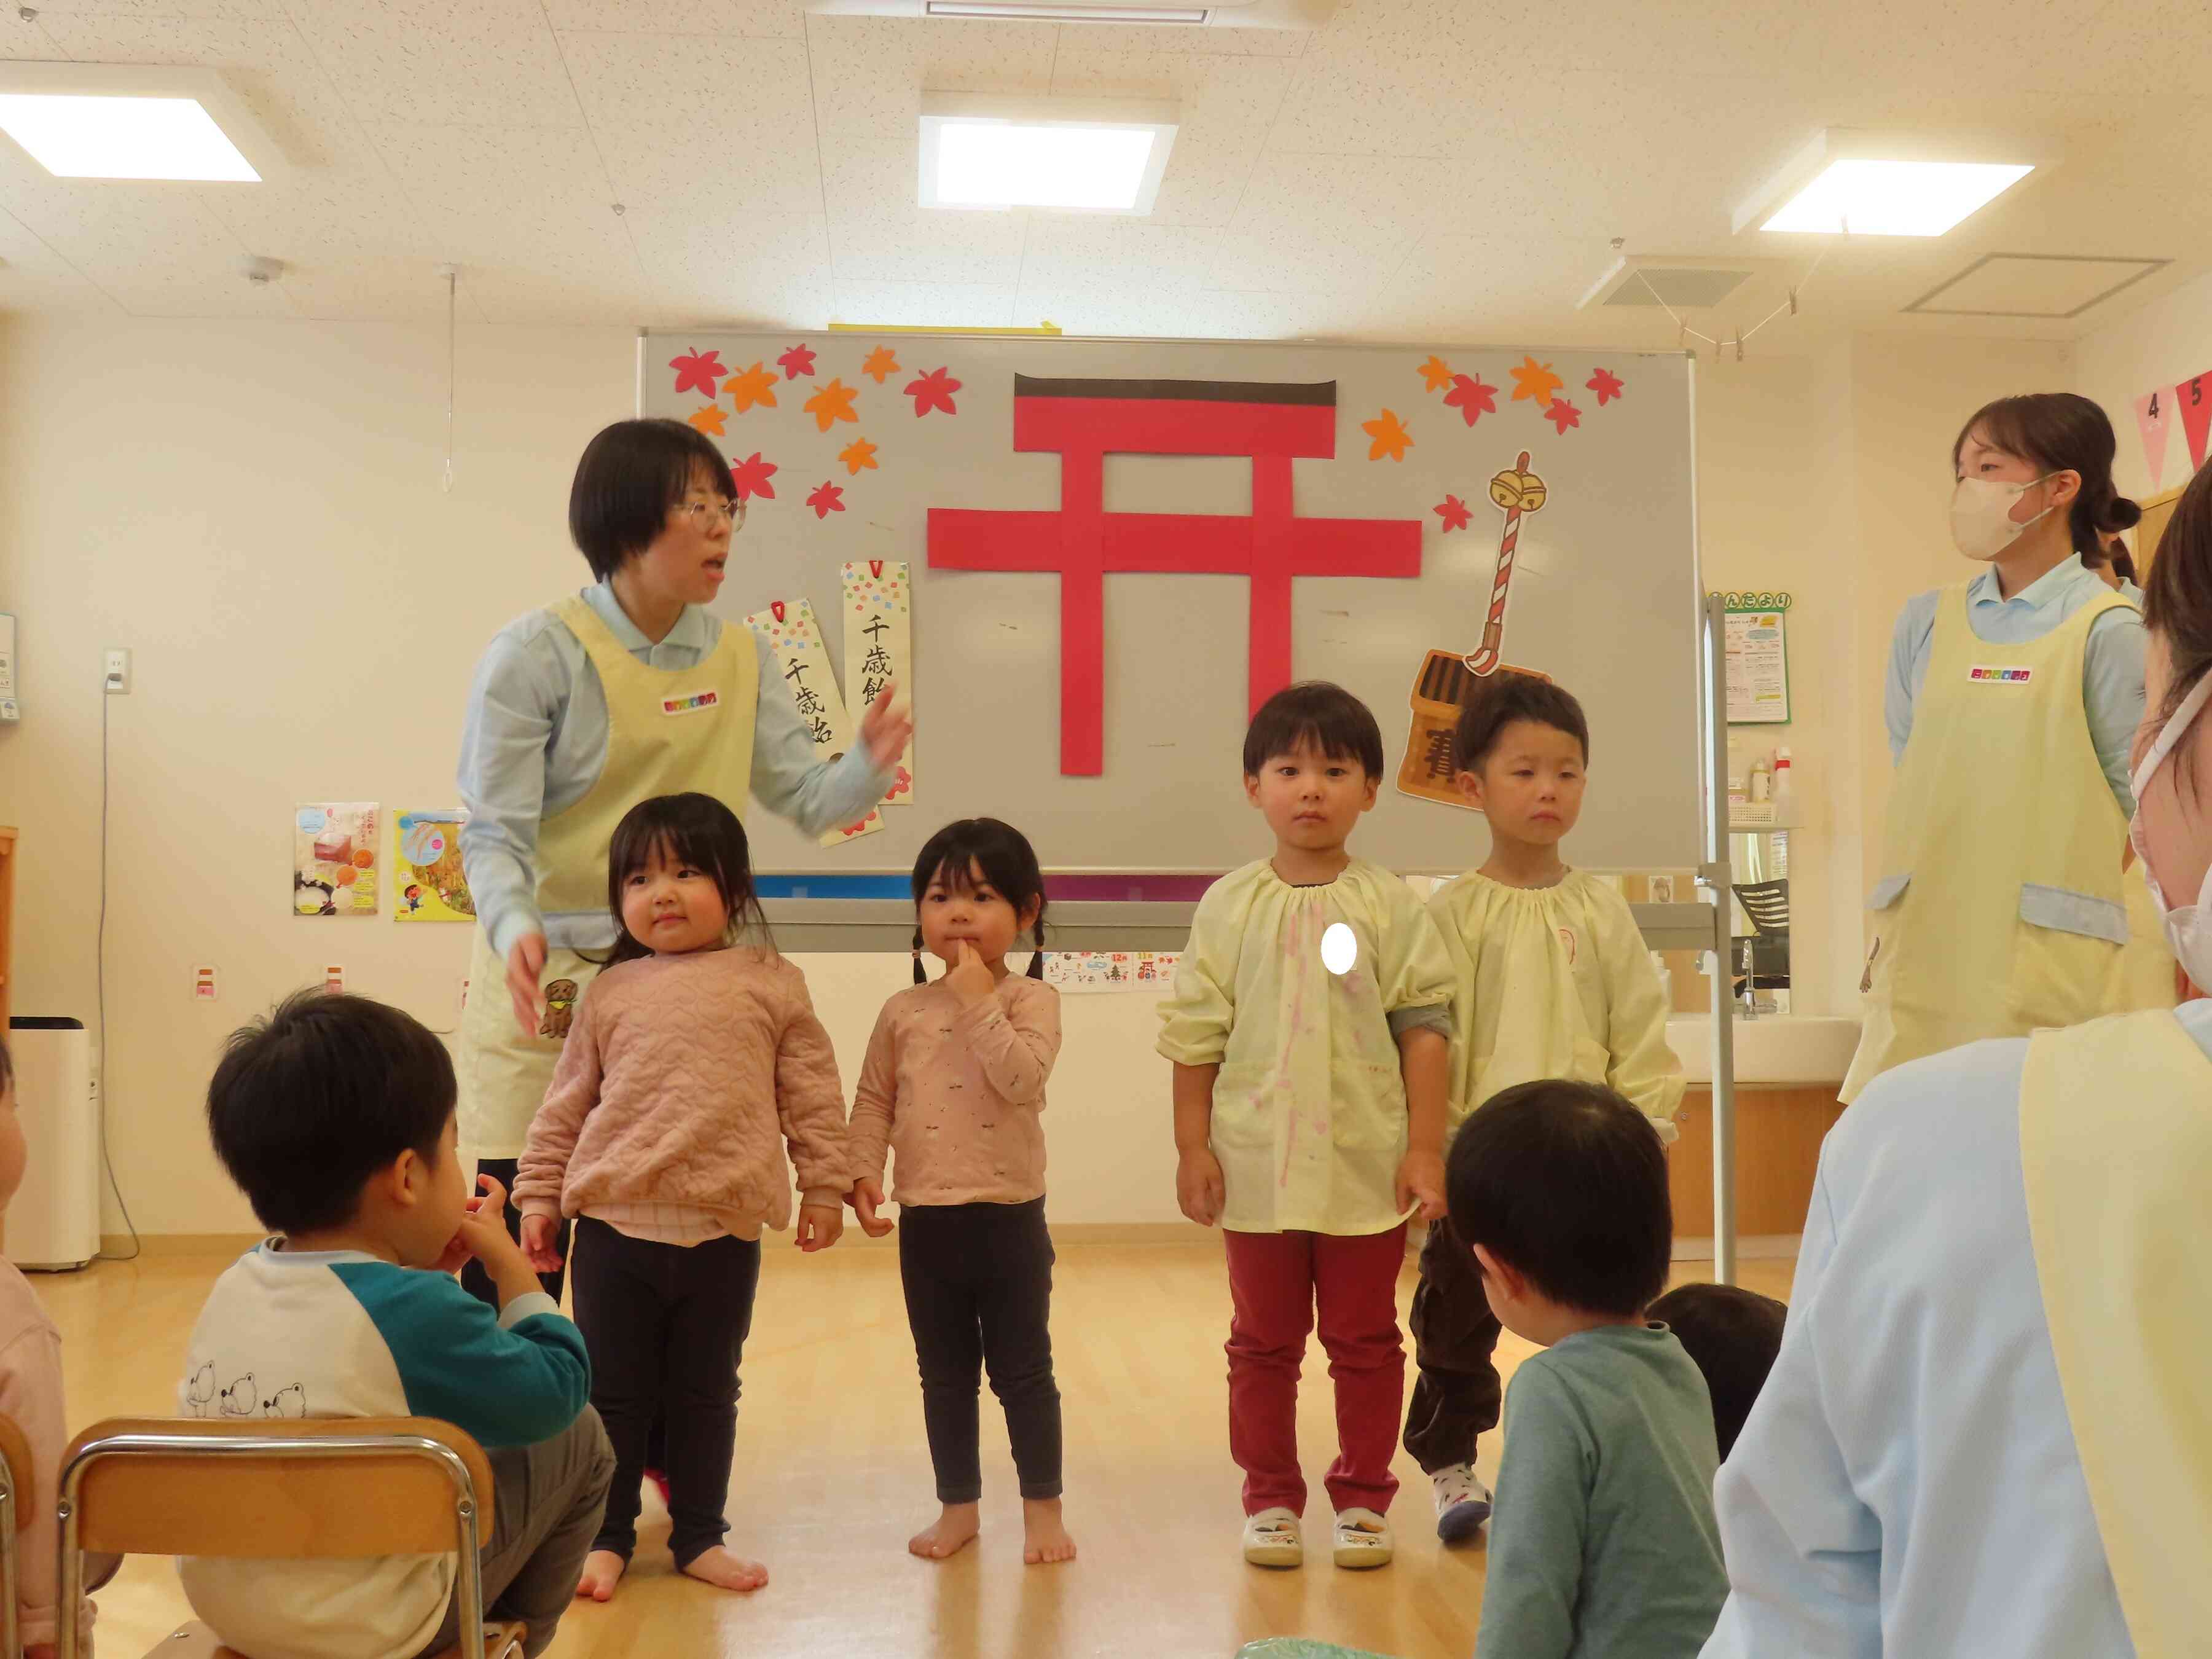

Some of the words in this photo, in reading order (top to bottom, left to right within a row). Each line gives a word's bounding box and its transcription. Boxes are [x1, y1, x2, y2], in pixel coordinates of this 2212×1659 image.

[2192, 377, 2202, 406] 5
[2148, 393, 2159, 419] 4
[1713, 593, 1789, 607] んだより
